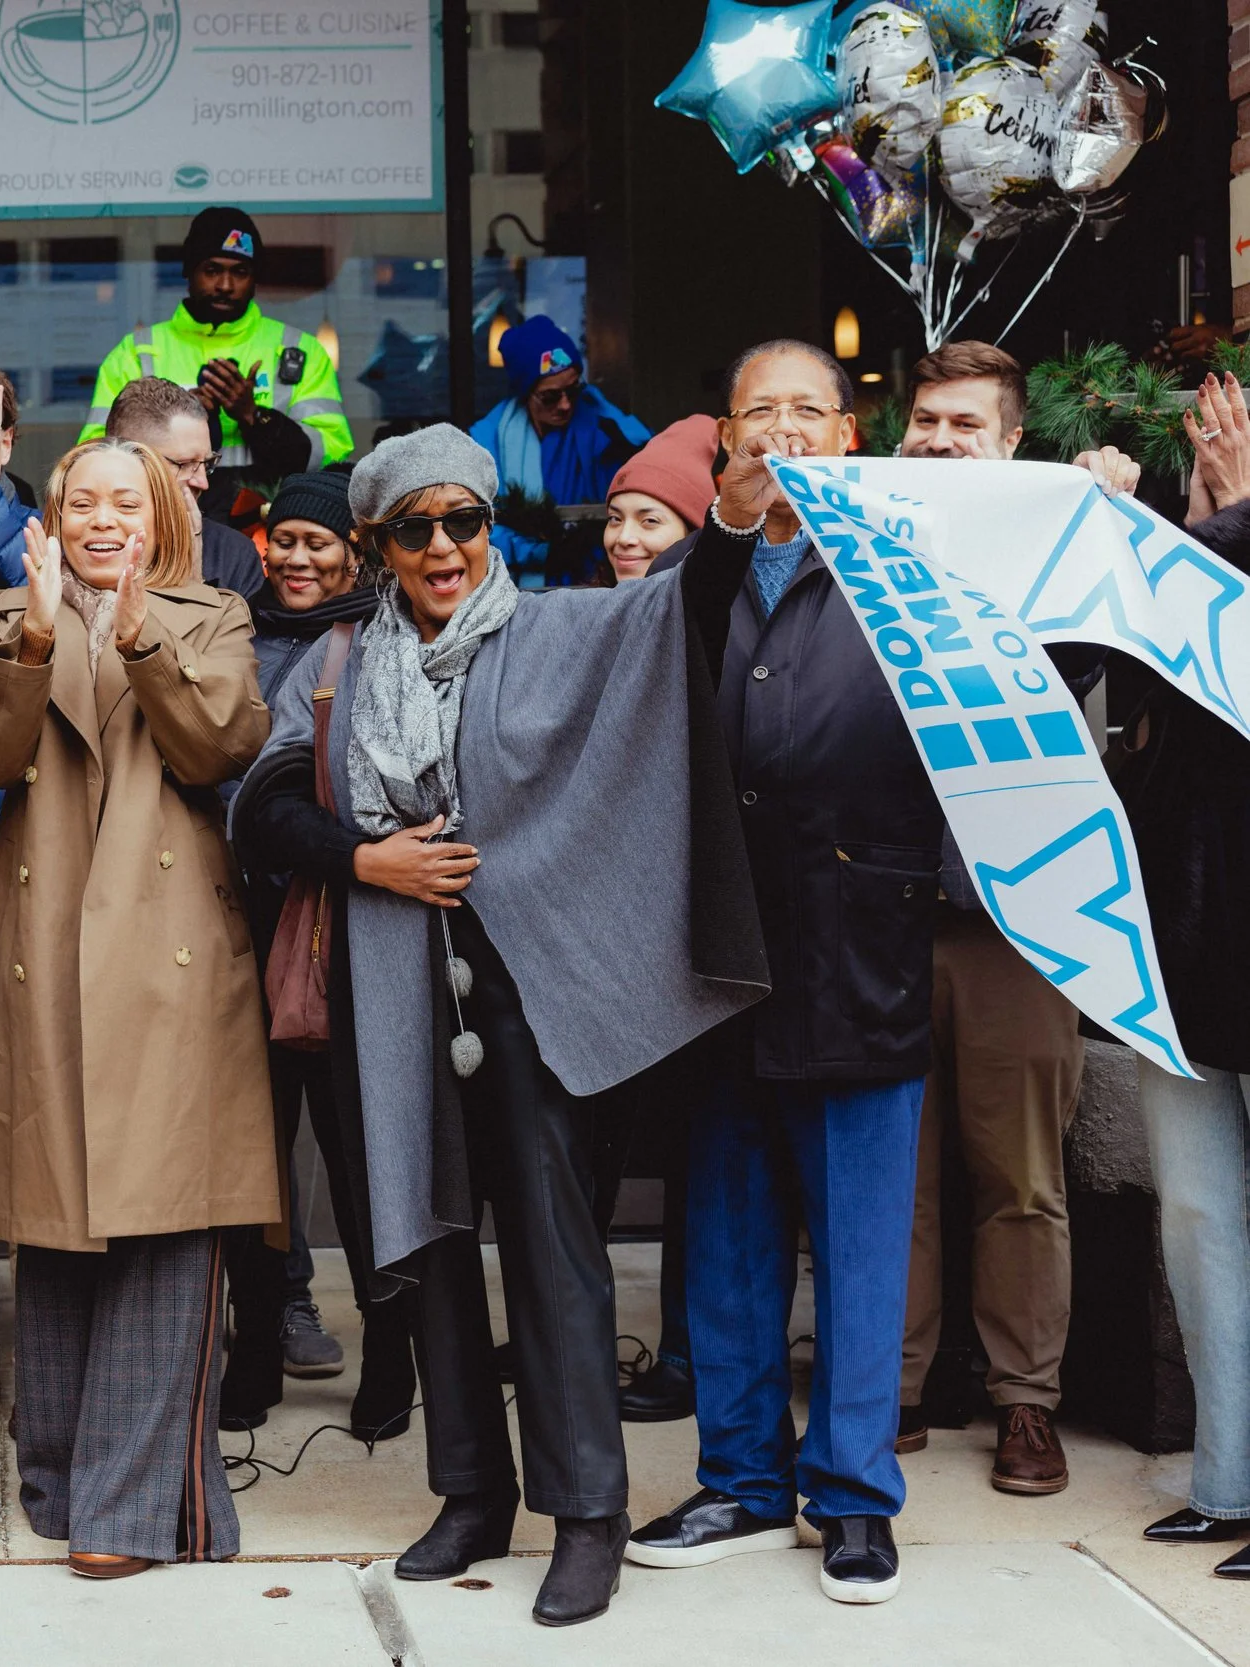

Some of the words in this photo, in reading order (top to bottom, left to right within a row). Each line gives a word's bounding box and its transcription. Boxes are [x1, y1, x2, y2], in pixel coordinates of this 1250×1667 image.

[193, 13, 288, 36] COFFEE
[296, 13, 312, 34] &
[318, 11, 418, 35] CUISINE
[231, 62, 373, 88] 901-872-1101
[191, 97, 413, 125] jaysmillington.com
[80, 170, 163, 190] SERVING
[216, 167, 291, 187] COFFEE
[295, 166, 346, 186] CHAT
[351, 165, 426, 185] COFFEE
